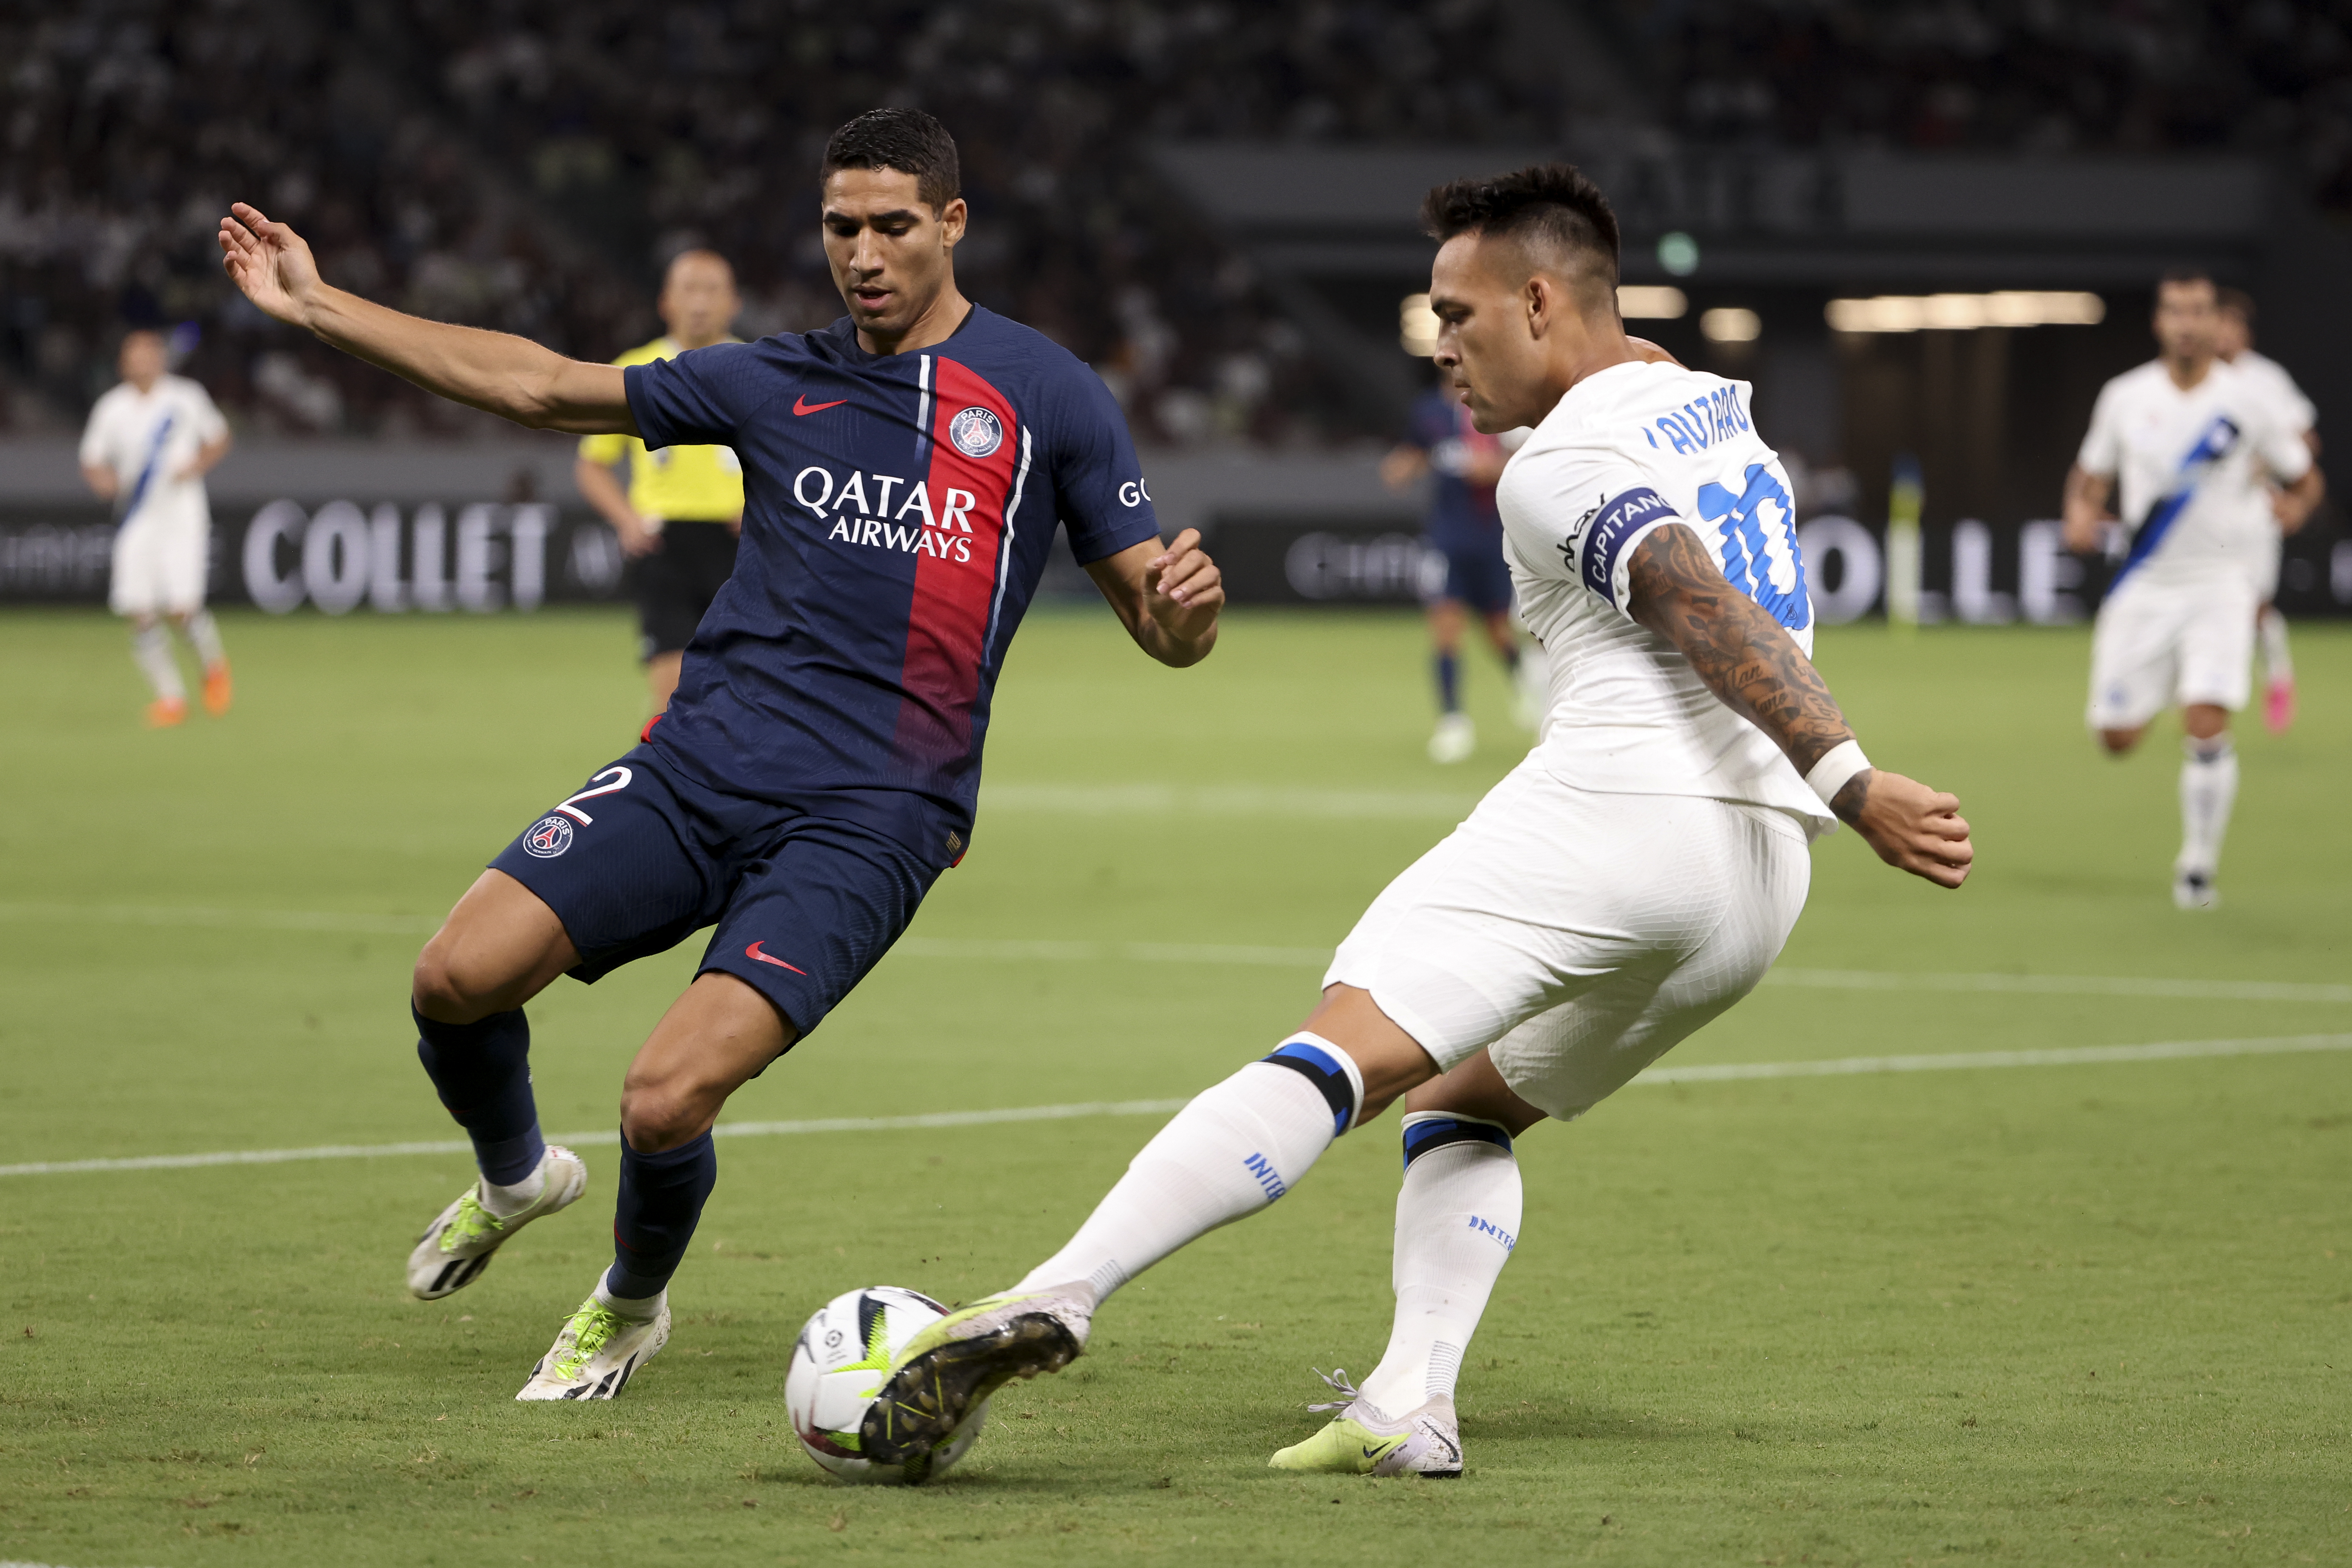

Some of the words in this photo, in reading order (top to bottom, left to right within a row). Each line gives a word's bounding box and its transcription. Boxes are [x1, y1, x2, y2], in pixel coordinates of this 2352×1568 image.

[960, 410, 994, 423] PARIS
[793, 466, 976, 533] QATAR
[242, 498, 560, 616] COLLET
[828, 515, 972, 563] AIRWAYS
[1698, 463, 1809, 630] 10
[553, 766, 632, 828] 2
[545, 819, 570, 835] PARIS
[1243, 1152, 1286, 1199] INTER
[1468, 1215, 1515, 1251] INTER
